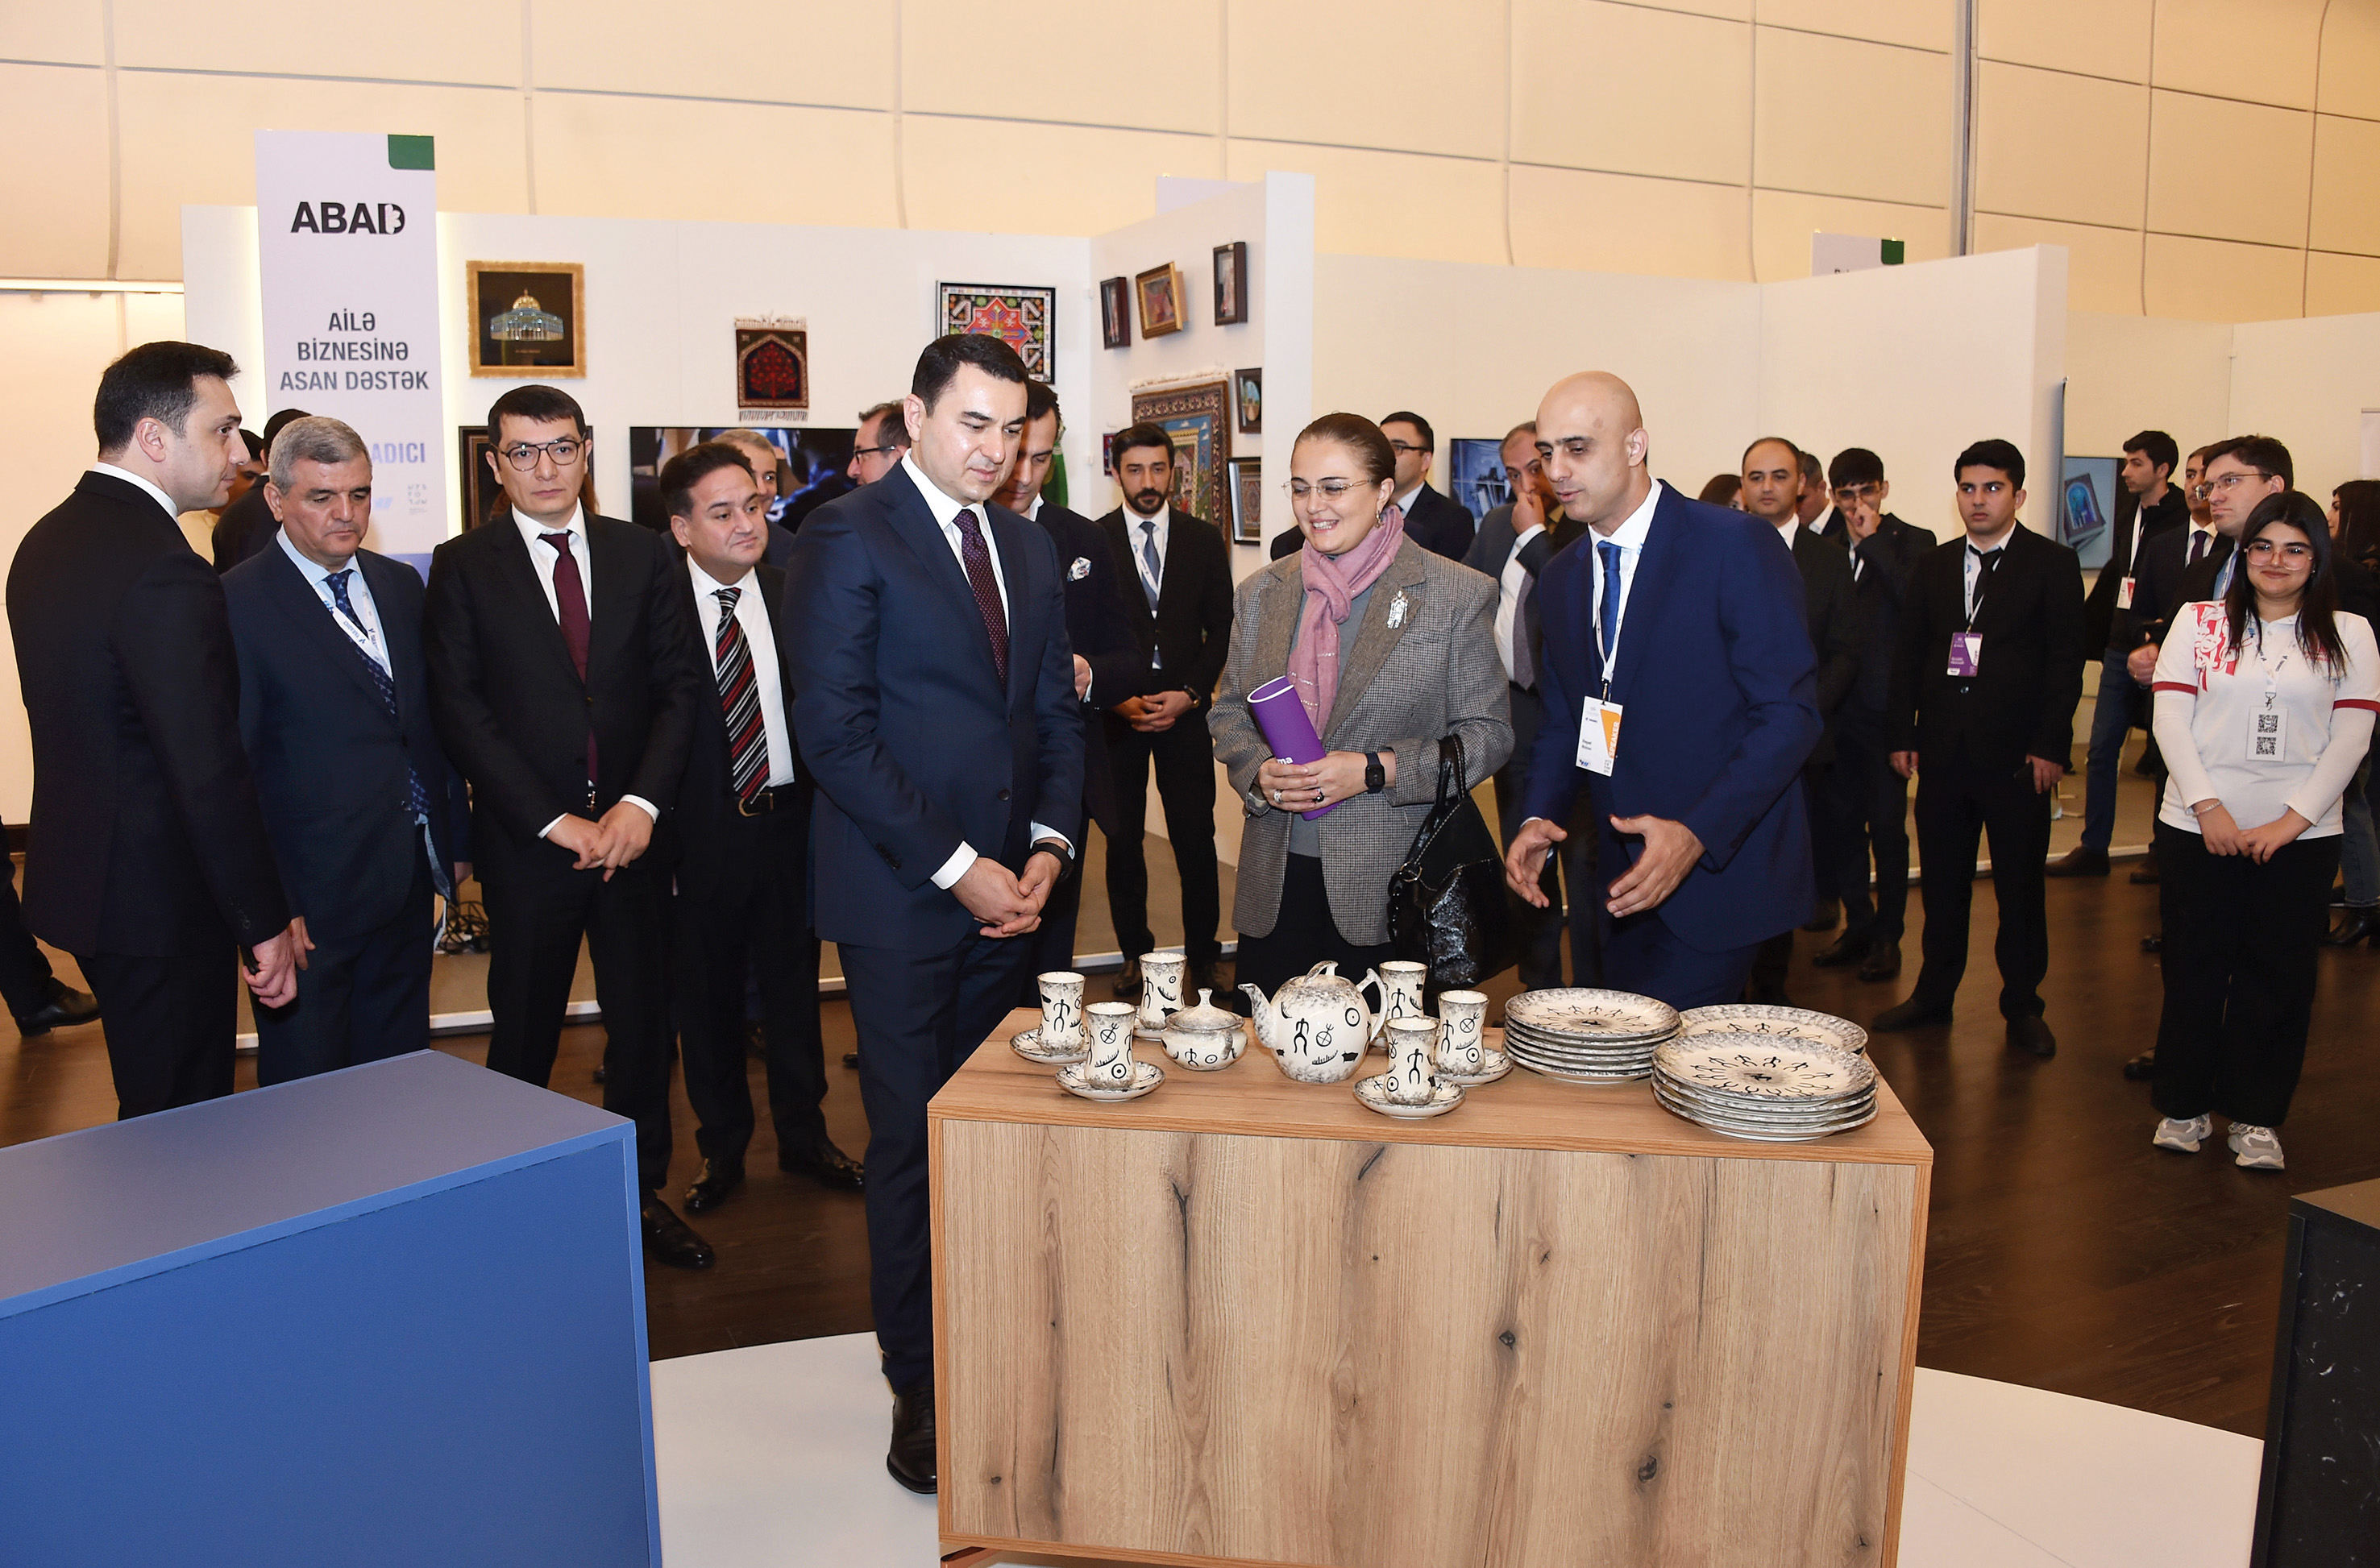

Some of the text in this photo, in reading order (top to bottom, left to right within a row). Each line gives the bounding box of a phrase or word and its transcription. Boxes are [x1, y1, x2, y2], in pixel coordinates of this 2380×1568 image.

[290, 201, 405, 234] ABAD
[328, 307, 376, 332] AİLƏ
[297, 338, 409, 361] BİZNESİNƏ
[280, 371, 430, 391] ASAN DƏSTƏK
[372, 442, 426, 463] ADICI
[1610, 721, 1620, 757] SPEAKER
